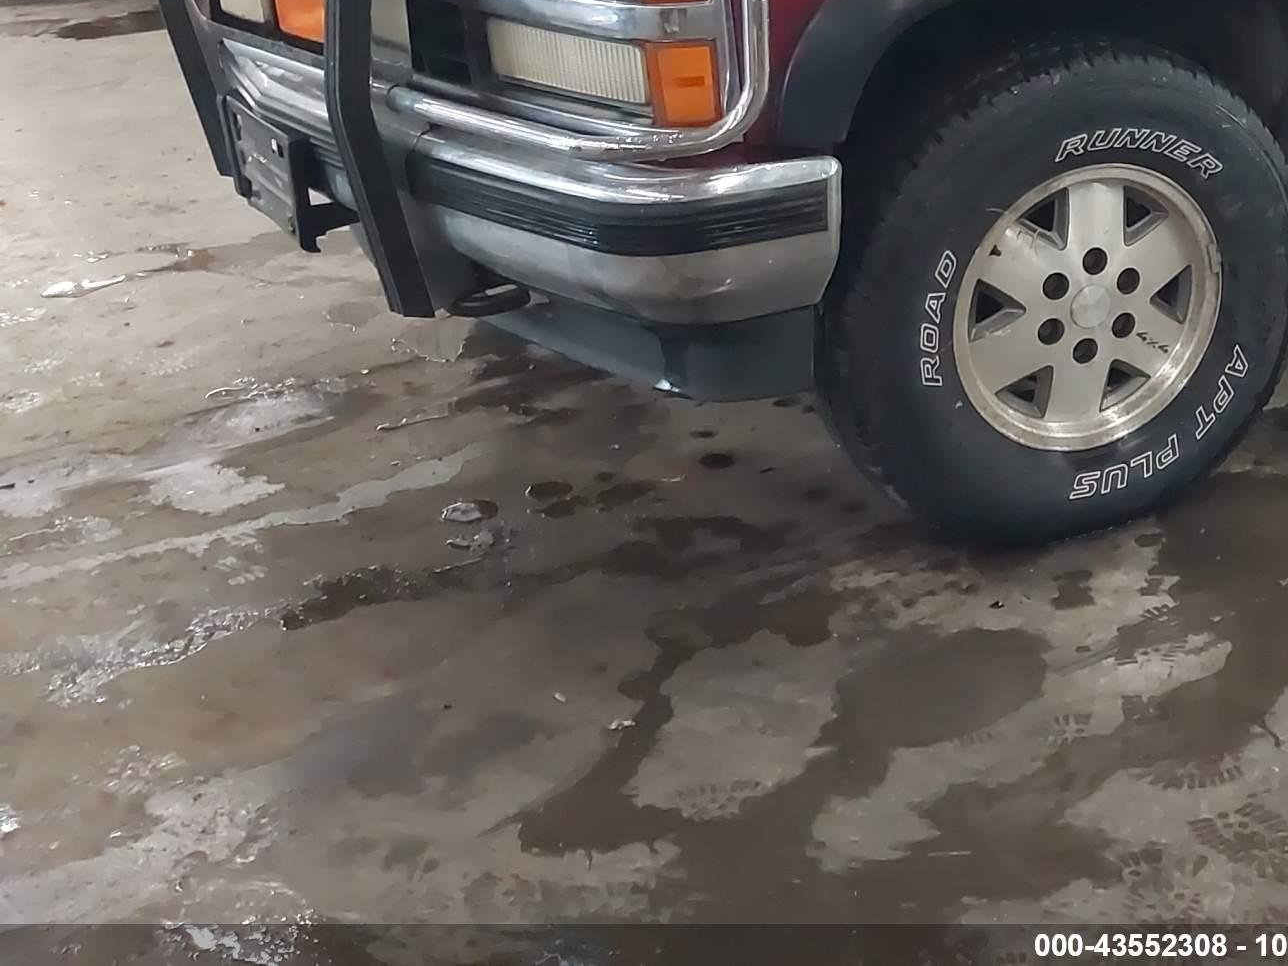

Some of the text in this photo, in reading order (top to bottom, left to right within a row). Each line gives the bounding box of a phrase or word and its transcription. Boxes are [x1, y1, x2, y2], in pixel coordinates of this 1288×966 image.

[920, 128, 1223, 386] ROAD RUNNER
[1069, 344, 1248, 499] APT PLUS
